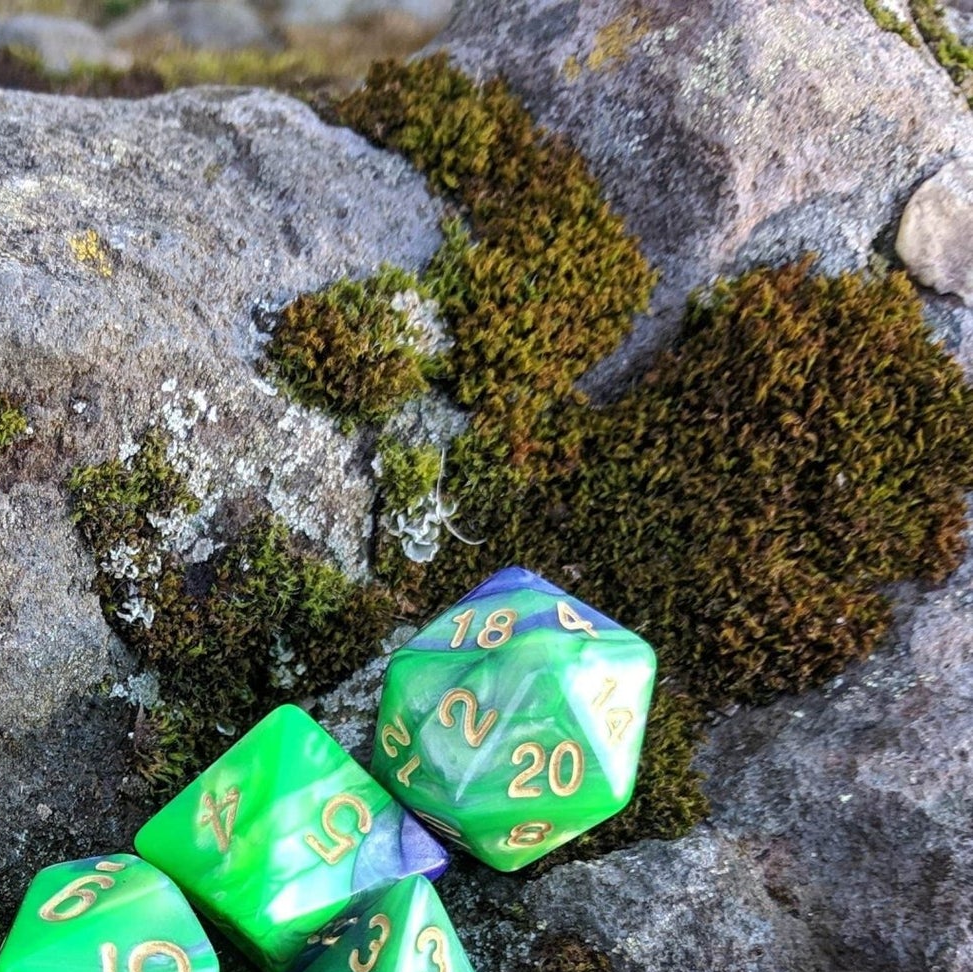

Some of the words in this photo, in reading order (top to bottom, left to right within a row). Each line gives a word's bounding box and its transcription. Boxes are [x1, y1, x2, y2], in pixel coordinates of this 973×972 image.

[450, 608, 519, 649] 18
[556, 601, 600, 638] 4
[438, 687, 498, 748] 2
[507, 740, 585, 799] 20
[201, 785, 241, 854] 4
[305, 792, 373, 865] 5
[507, 821, 554, 848] 8
